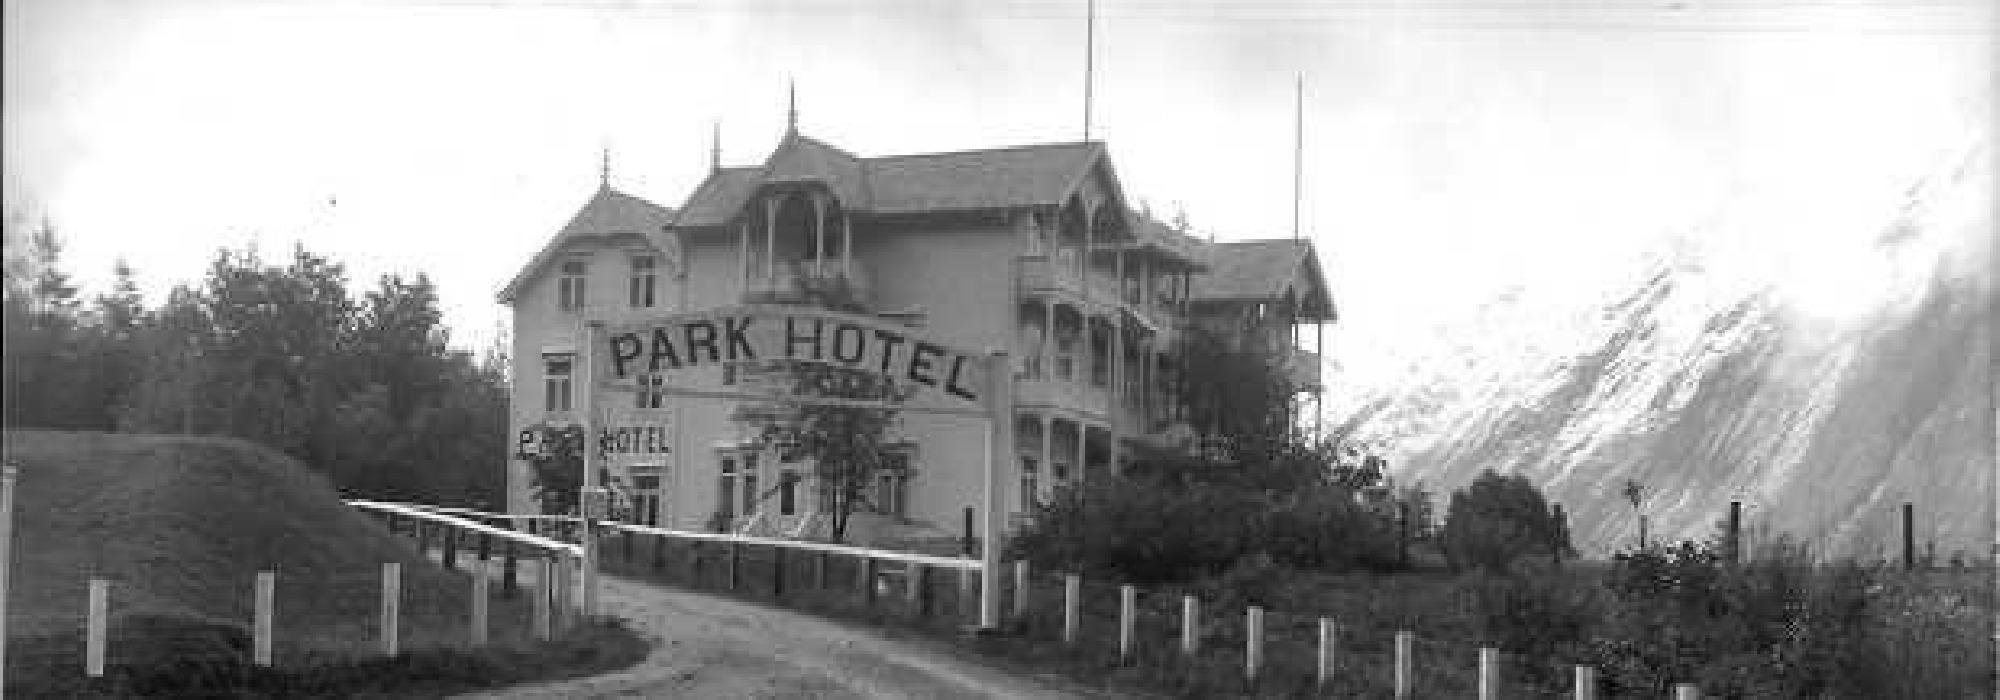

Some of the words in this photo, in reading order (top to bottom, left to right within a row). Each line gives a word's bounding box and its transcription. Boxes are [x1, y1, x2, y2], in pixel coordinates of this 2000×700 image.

[610, 316, 757, 379] PARK
[786, 315, 978, 401] HOTEL
[600, 426, 670, 454] HOTEL
